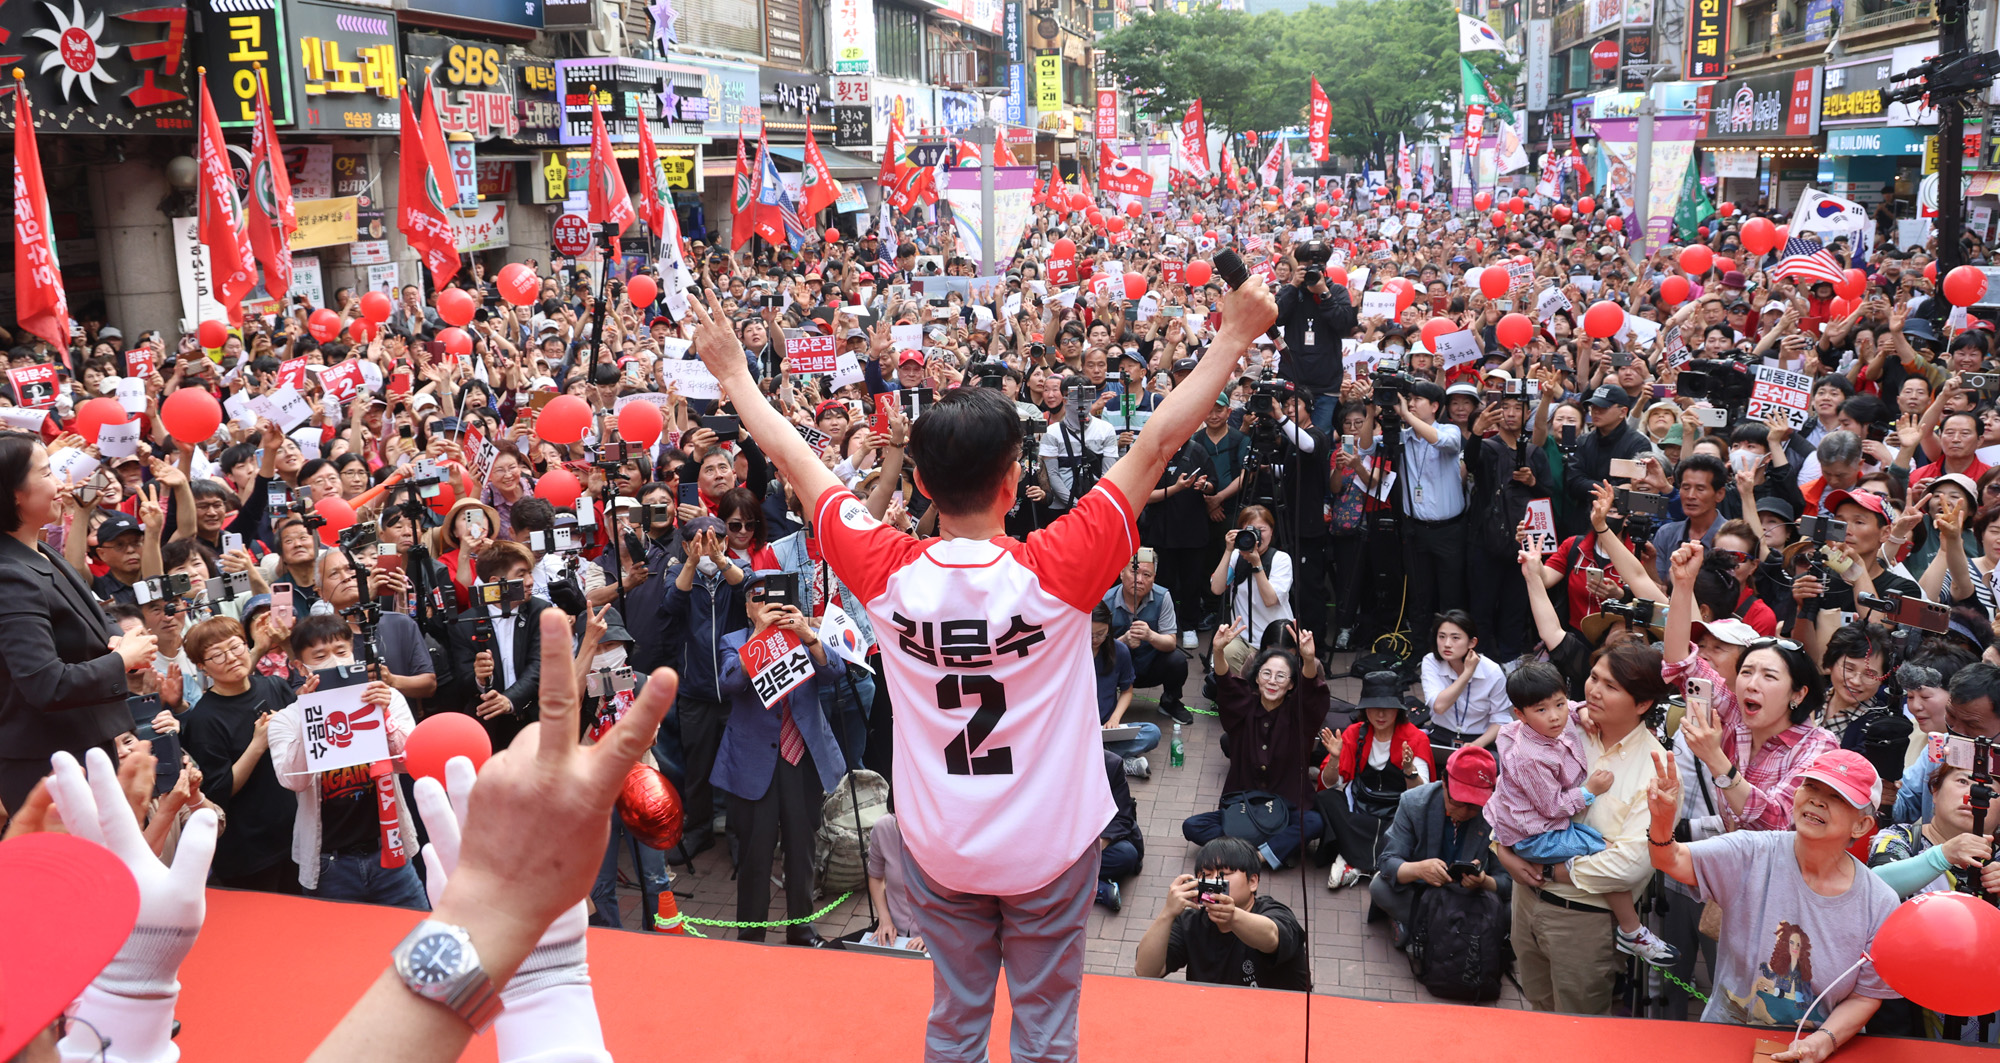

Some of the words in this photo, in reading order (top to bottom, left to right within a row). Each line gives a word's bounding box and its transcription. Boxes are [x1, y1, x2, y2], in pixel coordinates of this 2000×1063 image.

[840, 0, 858, 43] 겹살
[448, 45, 500, 85] SBS
[1704, 63, 1719, 73] B1
[525, 66, 556, 91] 베트남
[837, 81, 868, 102] 횟집
[344, 112, 372, 128] 연습장
[440, 90, 513, 138] 노래빠
[525, 101, 562, 128] 노래광장
[840, 110, 864, 122] 천사
[536, 133, 548, 144] B1
[840, 124, 864, 137] 곱창
[1840, 134, 1881, 150] BUILDING
[454, 147, 474, 187] 휴
[338, 179, 369, 193] BAR
[563, 217, 580, 226] 현대
[556, 227, 587, 244] 부동산
[1049, 258, 1073, 269] 김문수
[1164, 261, 1182, 270] 김문수
[1057, 271, 1069, 284] 2
[1168, 271, 1178, 283] 2
[787, 336, 833, 354] 형수존경
[127, 351, 150, 362] 김문수
[281, 357, 305, 373] 김문수
[790, 355, 835, 371] 측근생존
[15, 366, 53, 382] 김문수
[321, 362, 358, 384] 김문수
[1759, 367, 1810, 392] 대통령은
[339, 377, 353, 399] 2
[1754, 382, 1807, 408] 문수대통
[892, 610, 1047, 670] 김문수
[747, 639, 773, 674] 2
[753, 651, 812, 702] 김문수
[304, 705, 328, 761] 김문수
[326, 721, 347, 739] 2
[934, 673, 1015, 776] 2
